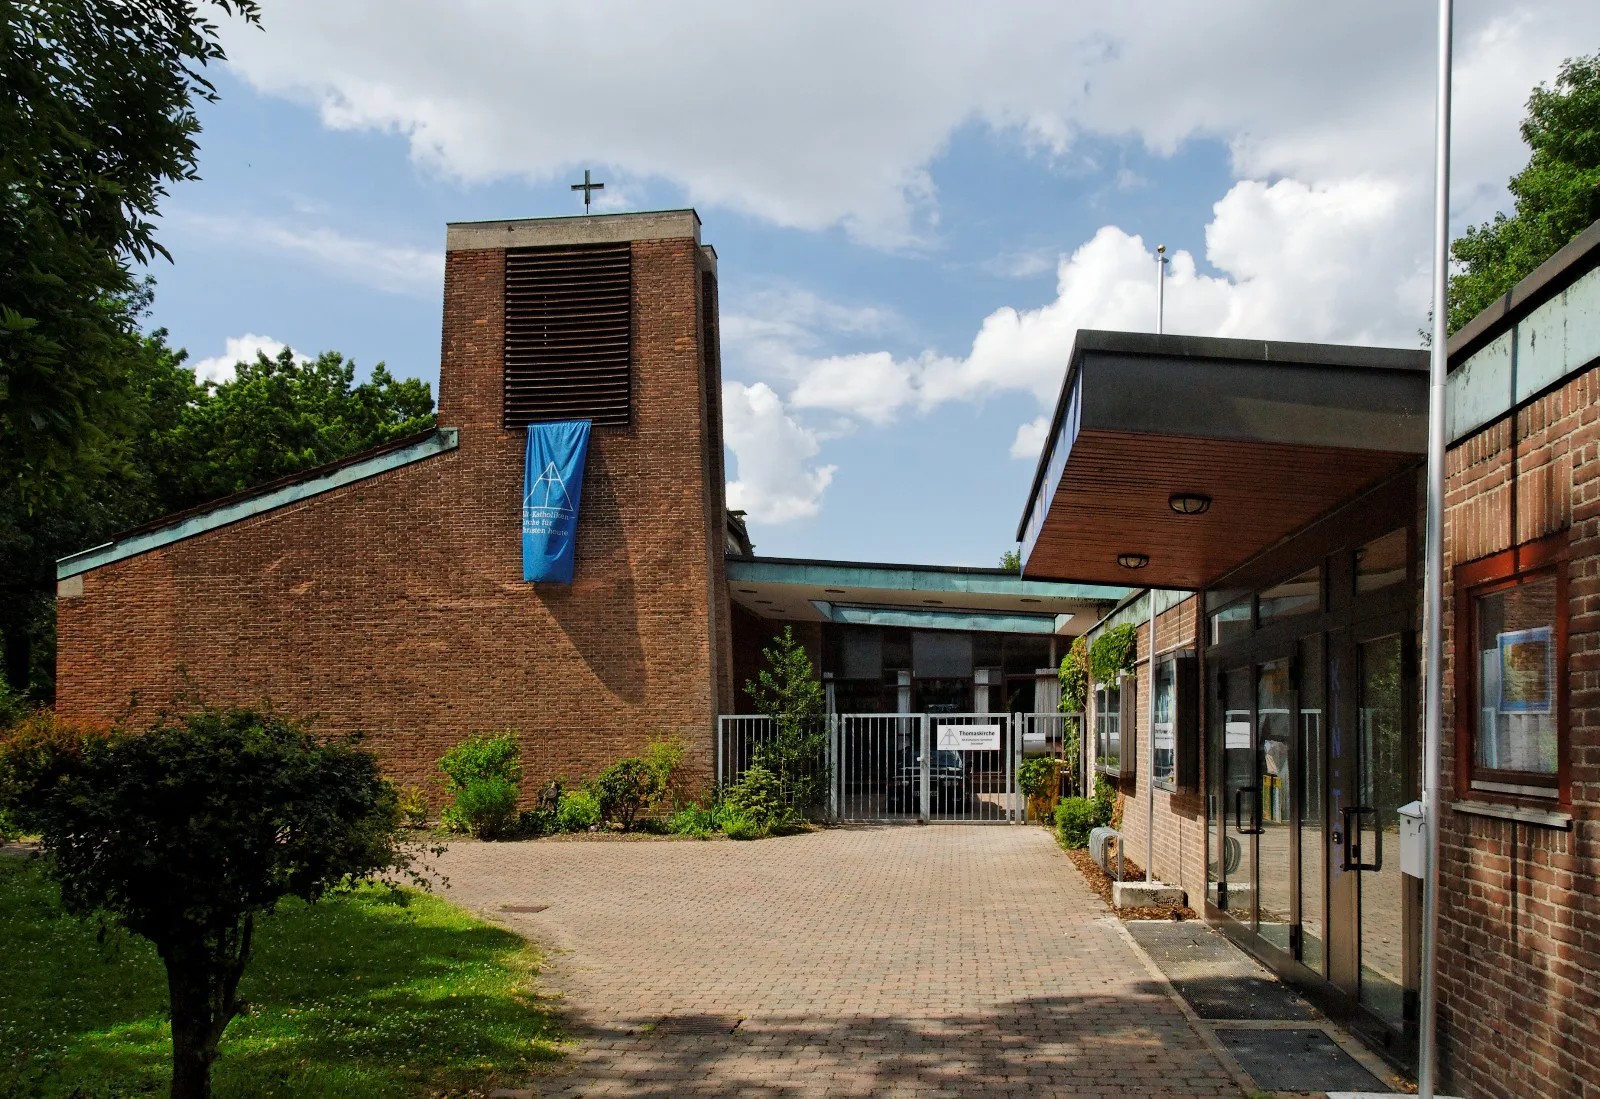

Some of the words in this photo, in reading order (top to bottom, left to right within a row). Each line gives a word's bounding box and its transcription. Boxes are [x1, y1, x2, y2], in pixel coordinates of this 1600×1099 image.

[523, 510, 569, 520] lt-Katholiken
[523, 518, 540, 526] irche
[541, 518, 552, 526] für
[523, 526, 545, 534] hristen
[548, 528, 569, 536] heute
